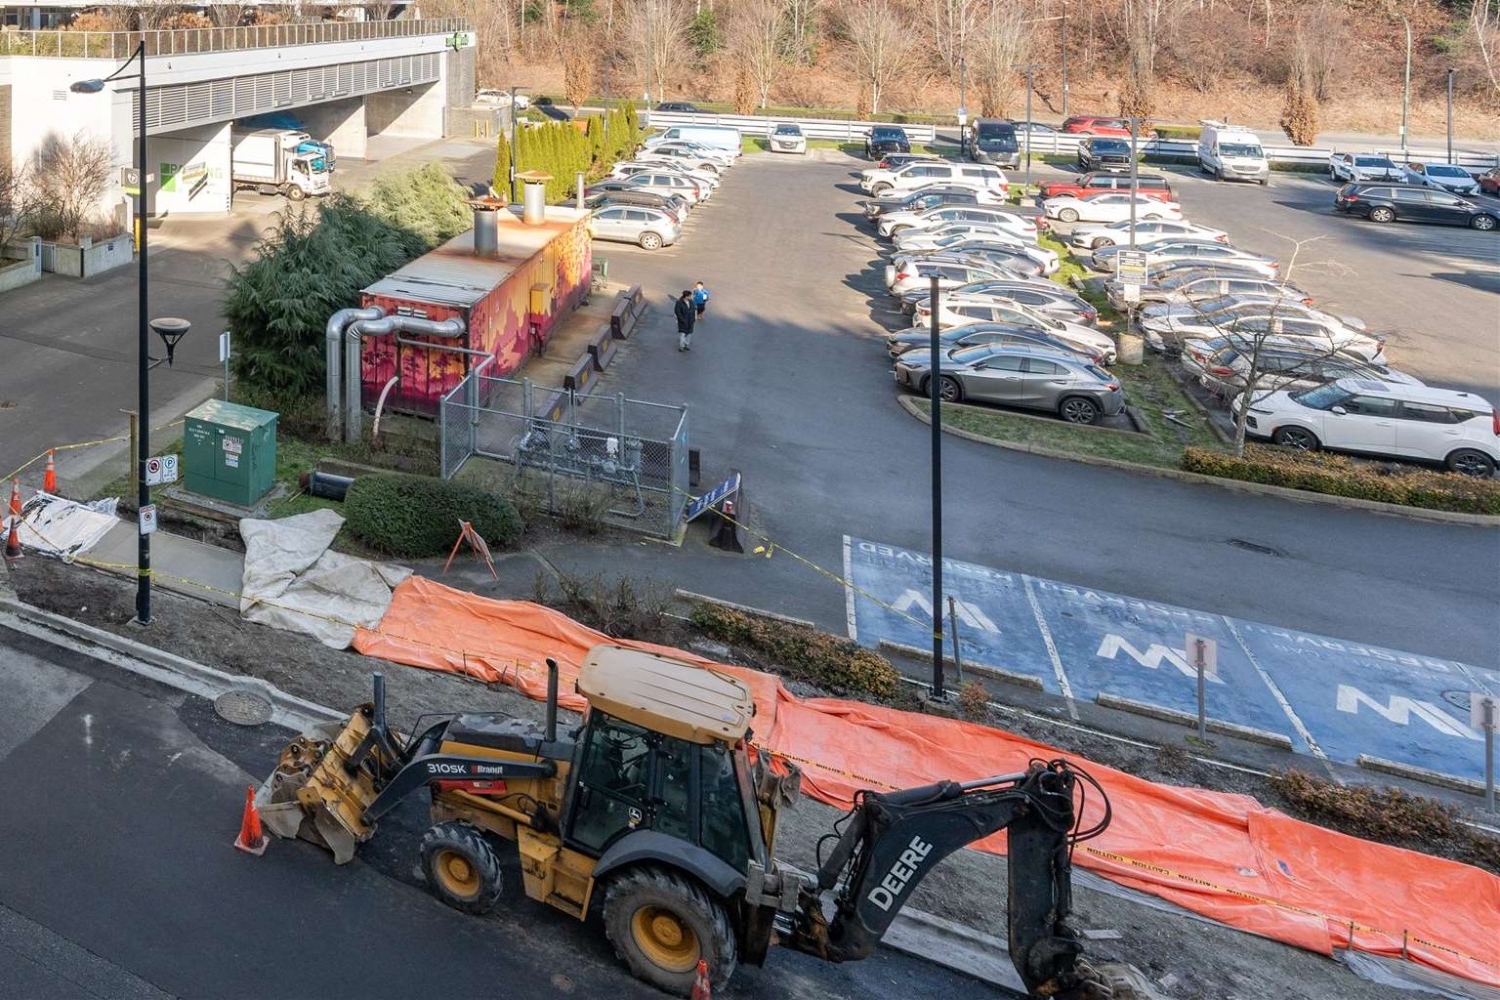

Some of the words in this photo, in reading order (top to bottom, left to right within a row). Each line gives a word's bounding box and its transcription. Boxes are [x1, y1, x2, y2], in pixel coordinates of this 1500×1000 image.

[427, 763, 467, 774] 310SK
[477, 765, 504, 775] Brandt
[1086, 846, 1123, 862] CAUTION
[867, 835, 933, 912] DEERE
[1131, 860, 1170, 876] CAUTION
[1178, 874, 1218, 889] CAUTION
